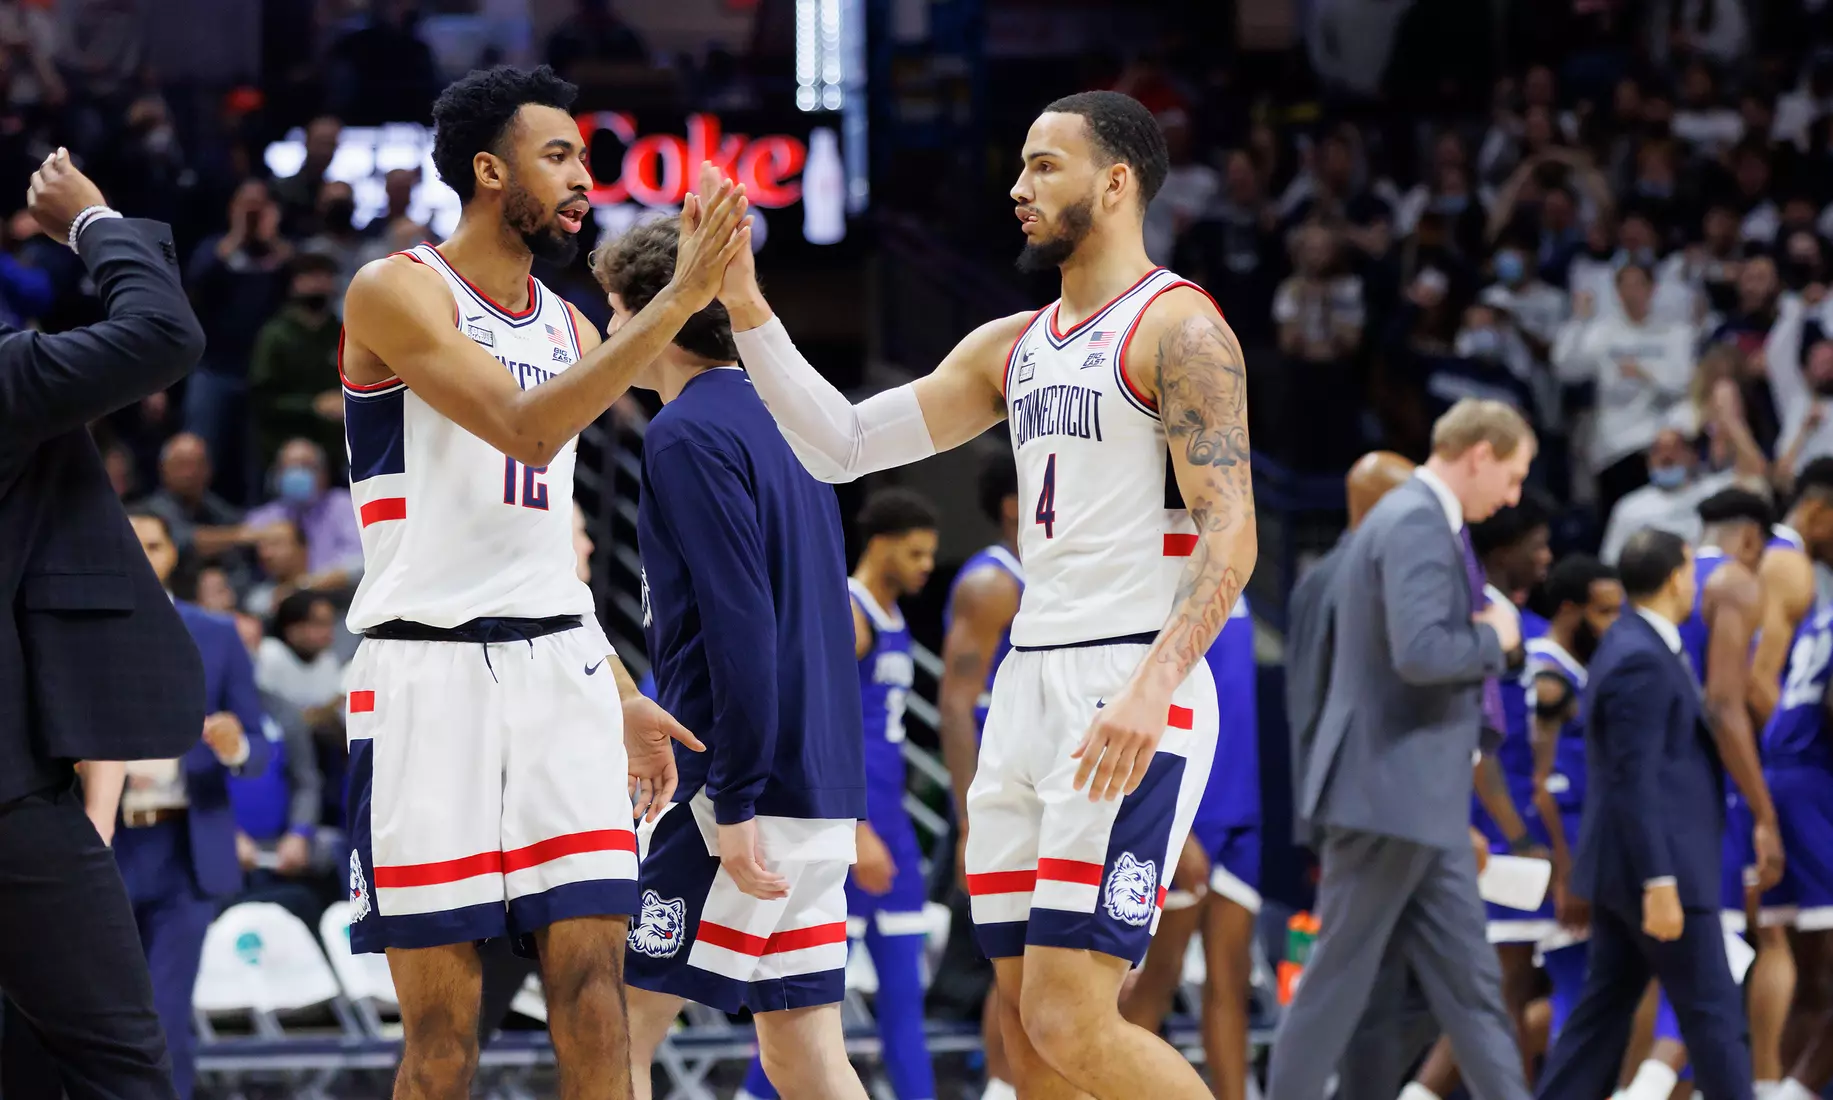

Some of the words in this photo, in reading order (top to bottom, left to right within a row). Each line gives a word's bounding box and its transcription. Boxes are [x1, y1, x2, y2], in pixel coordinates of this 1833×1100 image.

[574, 110, 807, 208] Coke
[553, 347, 568, 357] BIG
[1087, 352, 1104, 360] BIG
[552, 353, 572, 363] EAST
[1082, 358, 1106, 366] EAST
[1013, 384, 1103, 449] CONNECTICUT
[1035, 453, 1056, 539] 4
